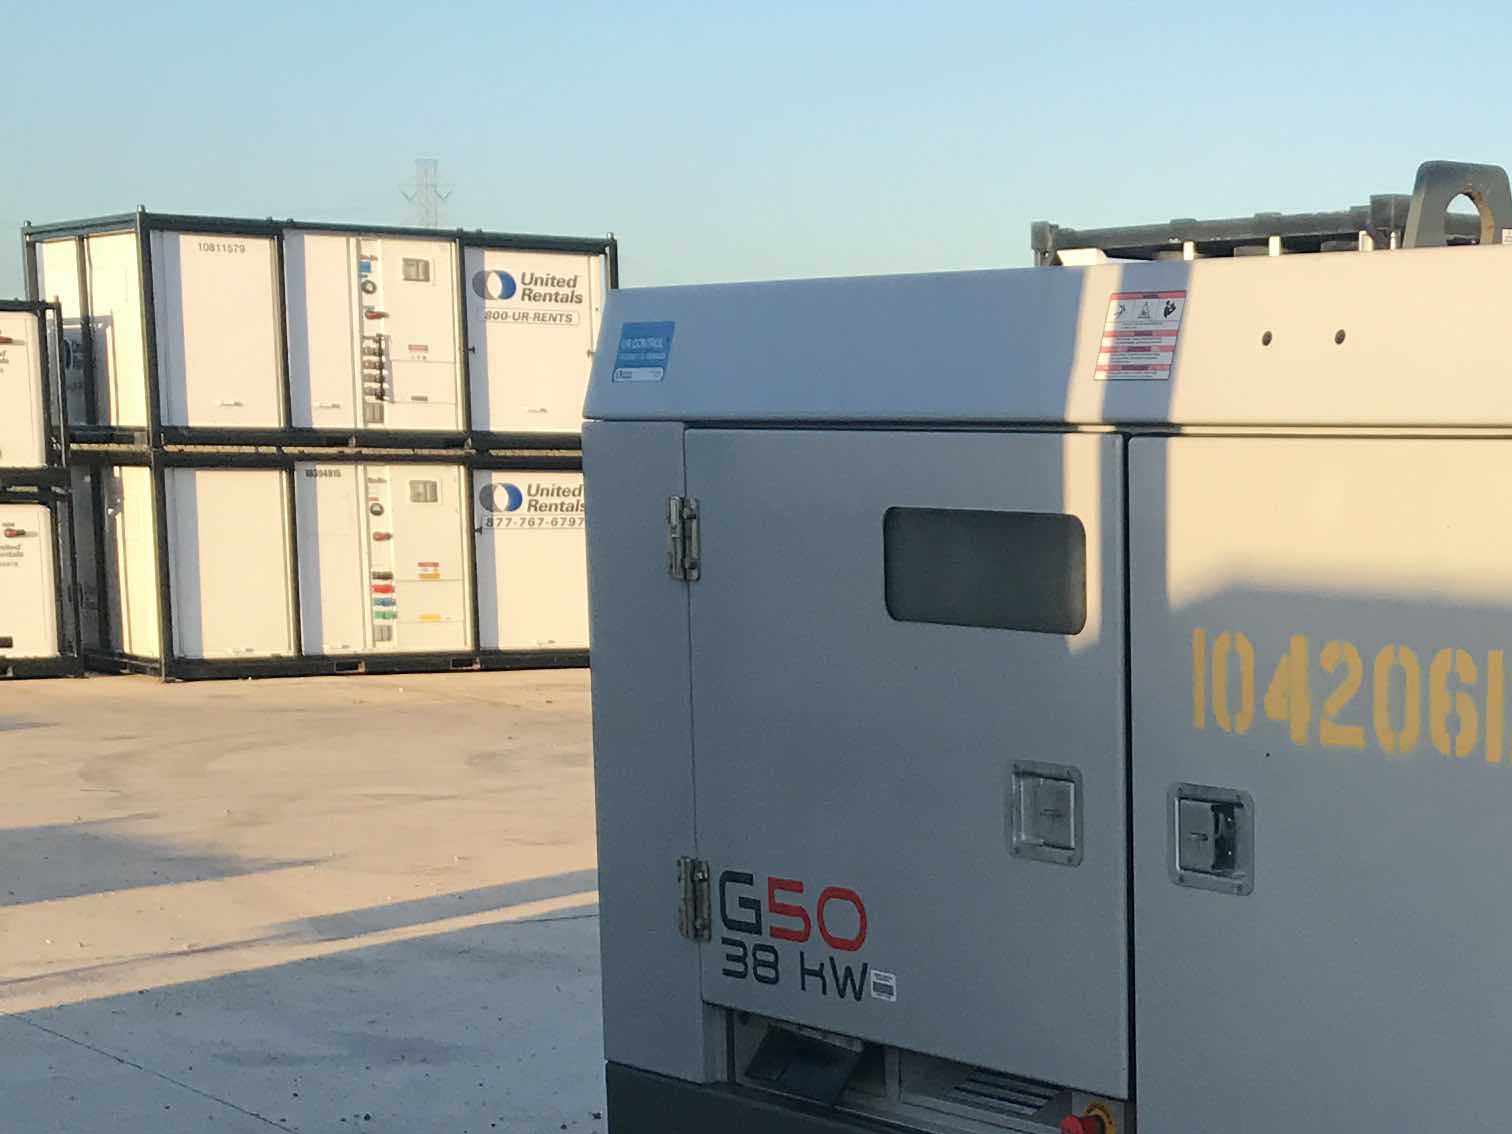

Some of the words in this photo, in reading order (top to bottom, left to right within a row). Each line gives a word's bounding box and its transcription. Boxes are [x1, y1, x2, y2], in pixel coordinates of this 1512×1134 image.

[520, 272, 577, 288] United
[520, 287, 583, 304] Rentals
[527, 483, 584, 498] United
[719, 870, 868, 951] G50
[721, 936, 780, 985] 38
